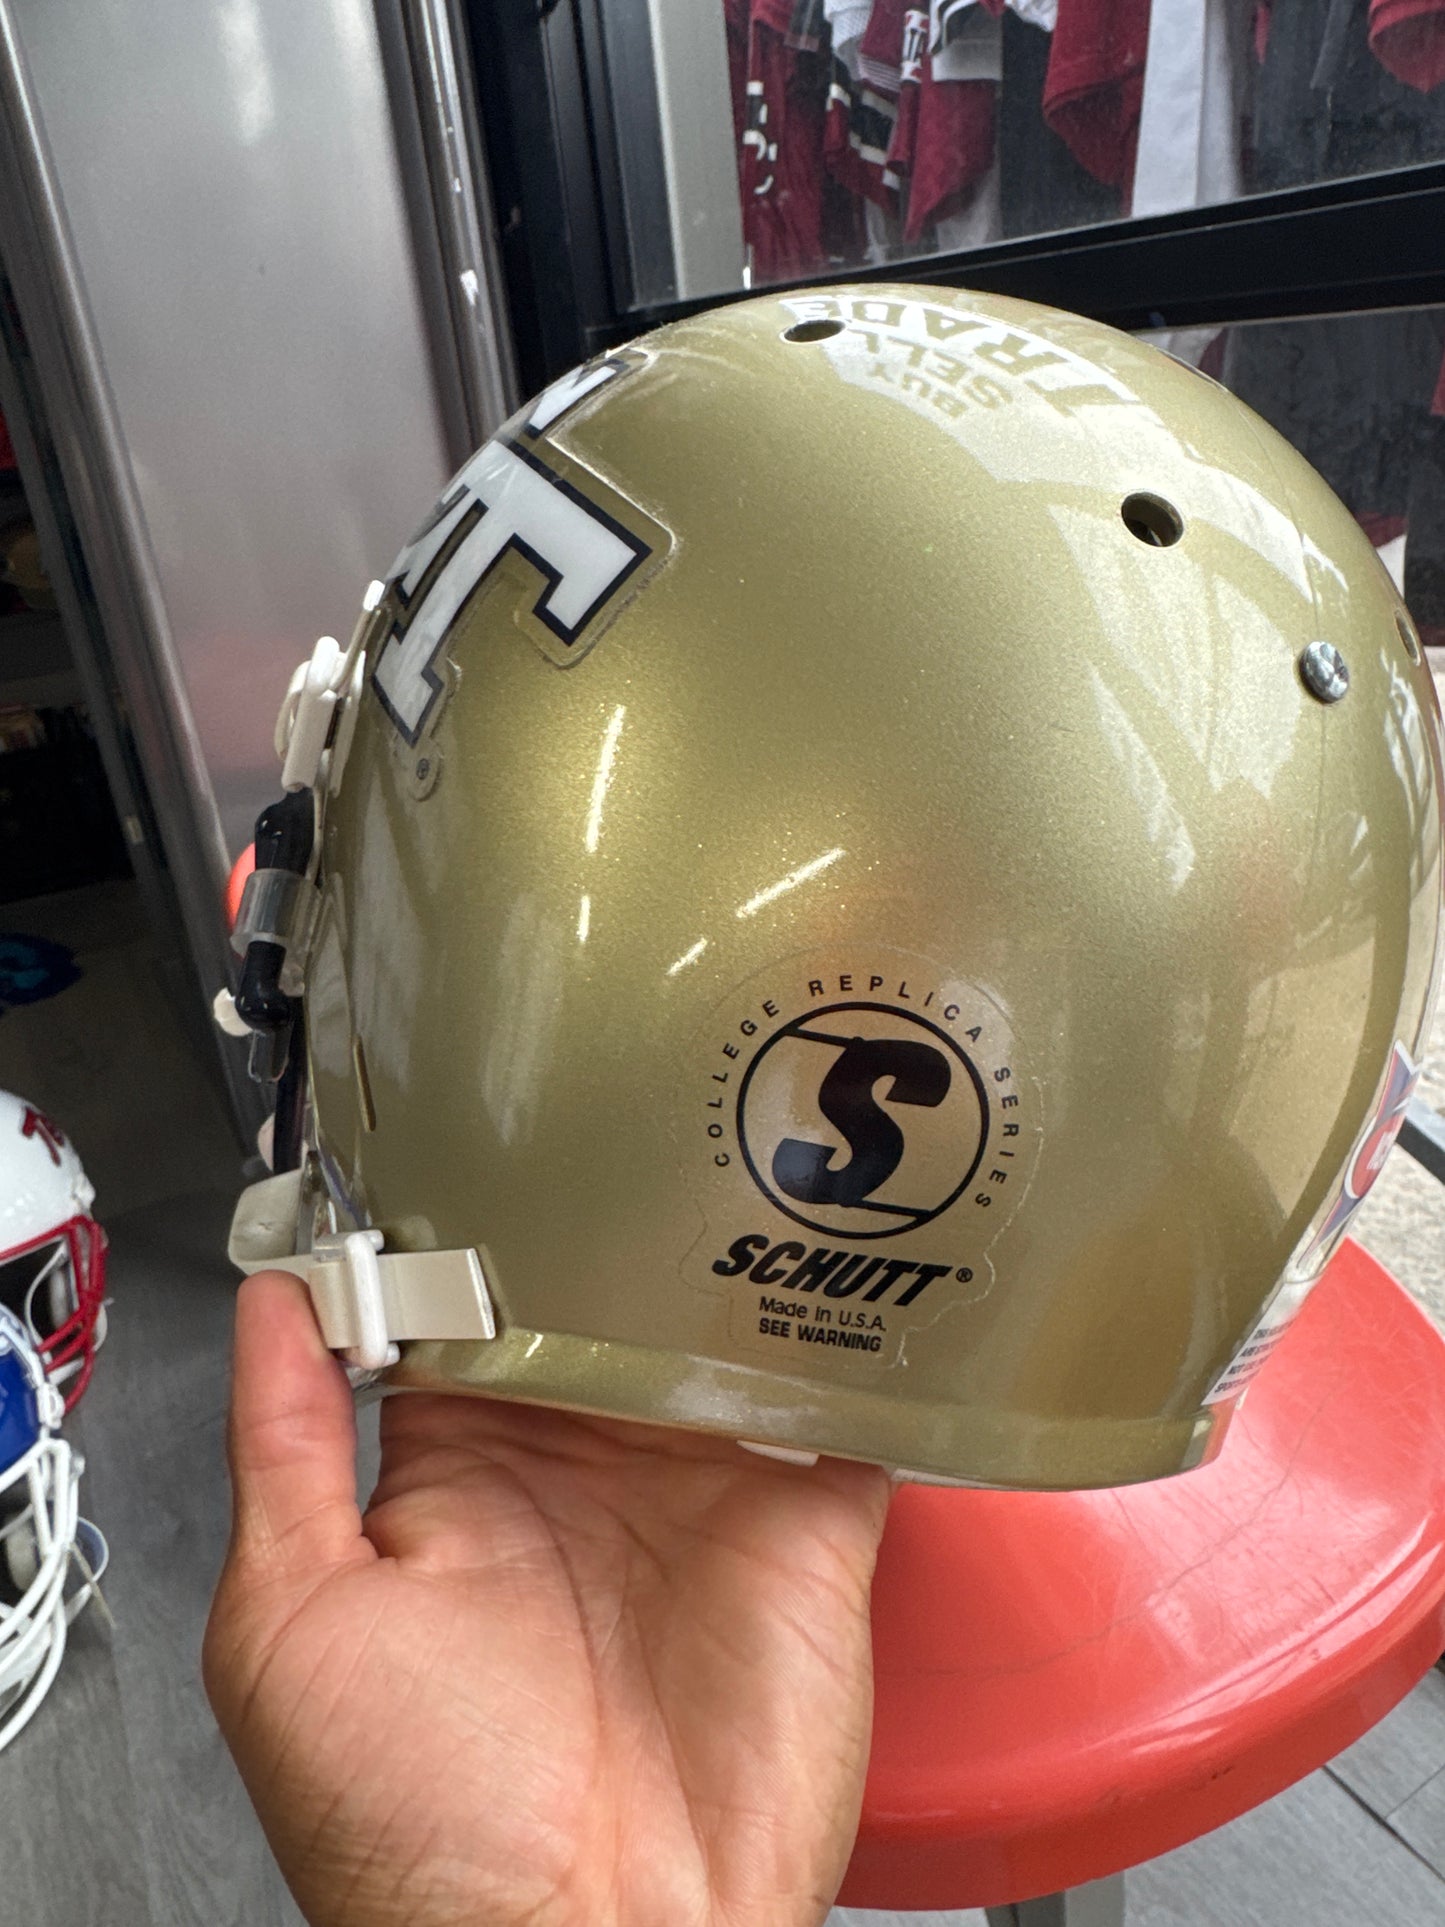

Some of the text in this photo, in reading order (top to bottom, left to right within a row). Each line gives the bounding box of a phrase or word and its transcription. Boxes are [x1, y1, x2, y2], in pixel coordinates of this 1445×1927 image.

[801, 299, 1139, 418] TRADE
[848, 328, 1012, 411] SELL
[869, 361, 968, 420] BUY
[707, 974, 1020, 1208] COLLEGE REPLICA SERIES
[772, 1036, 952, 1206] S
[759, 1296, 808, 1319] Made
[759, 1317, 882, 1352] SEE WARNING
